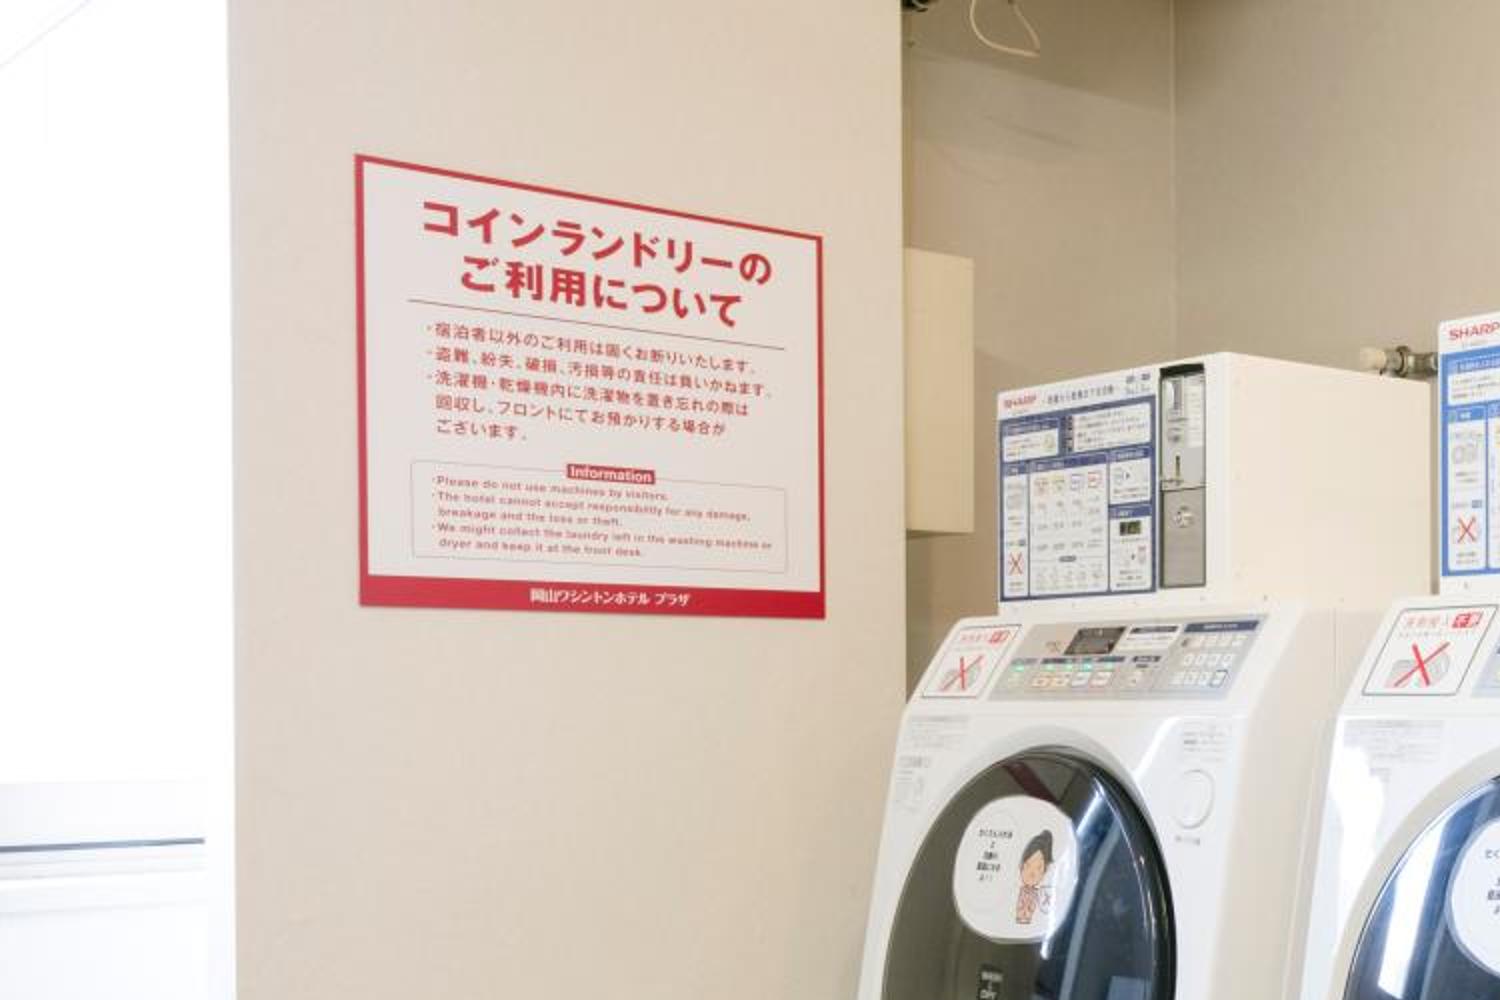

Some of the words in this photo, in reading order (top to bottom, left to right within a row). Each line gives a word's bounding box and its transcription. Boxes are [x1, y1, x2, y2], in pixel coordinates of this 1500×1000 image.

[423, 201, 772, 285] コインランドリーの
[461, 255, 741, 327] ご利用について
[1449, 321, 1500, 341] SHARP
[436, 419, 527, 440] ございます。
[570, 466, 653, 484] Information
[436, 475, 479, 488] Please
[482, 479, 498, 490] do
[501, 481, 521, 491] not
[525, 483, 547, 493] use
[550, 483, 606, 497] machines
[438, 491, 461, 502] The
[499, 496, 542, 507] cannot
[544, 499, 585, 511] accept
[438, 507, 497, 520] breakage
[500, 510, 523, 521] and
[527, 511, 545, 522] the
[548, 512, 573, 523] loss
[437, 523, 456, 533] We
[459, 524, 496, 537] might
[499, 526, 540, 538] collect
[543, 528, 563, 538] the
[565, 529, 609, 543] laundry
[439, 538, 473, 550] dryer
[475, 539, 499, 550] and
[502, 540, 531, 552] keep
[535, 541, 544, 552] it
[562, 543, 581, 554] the
[530, 587, 651, 606] 岡山ワシントンホテル
[655, 591, 691, 608] プラザ
